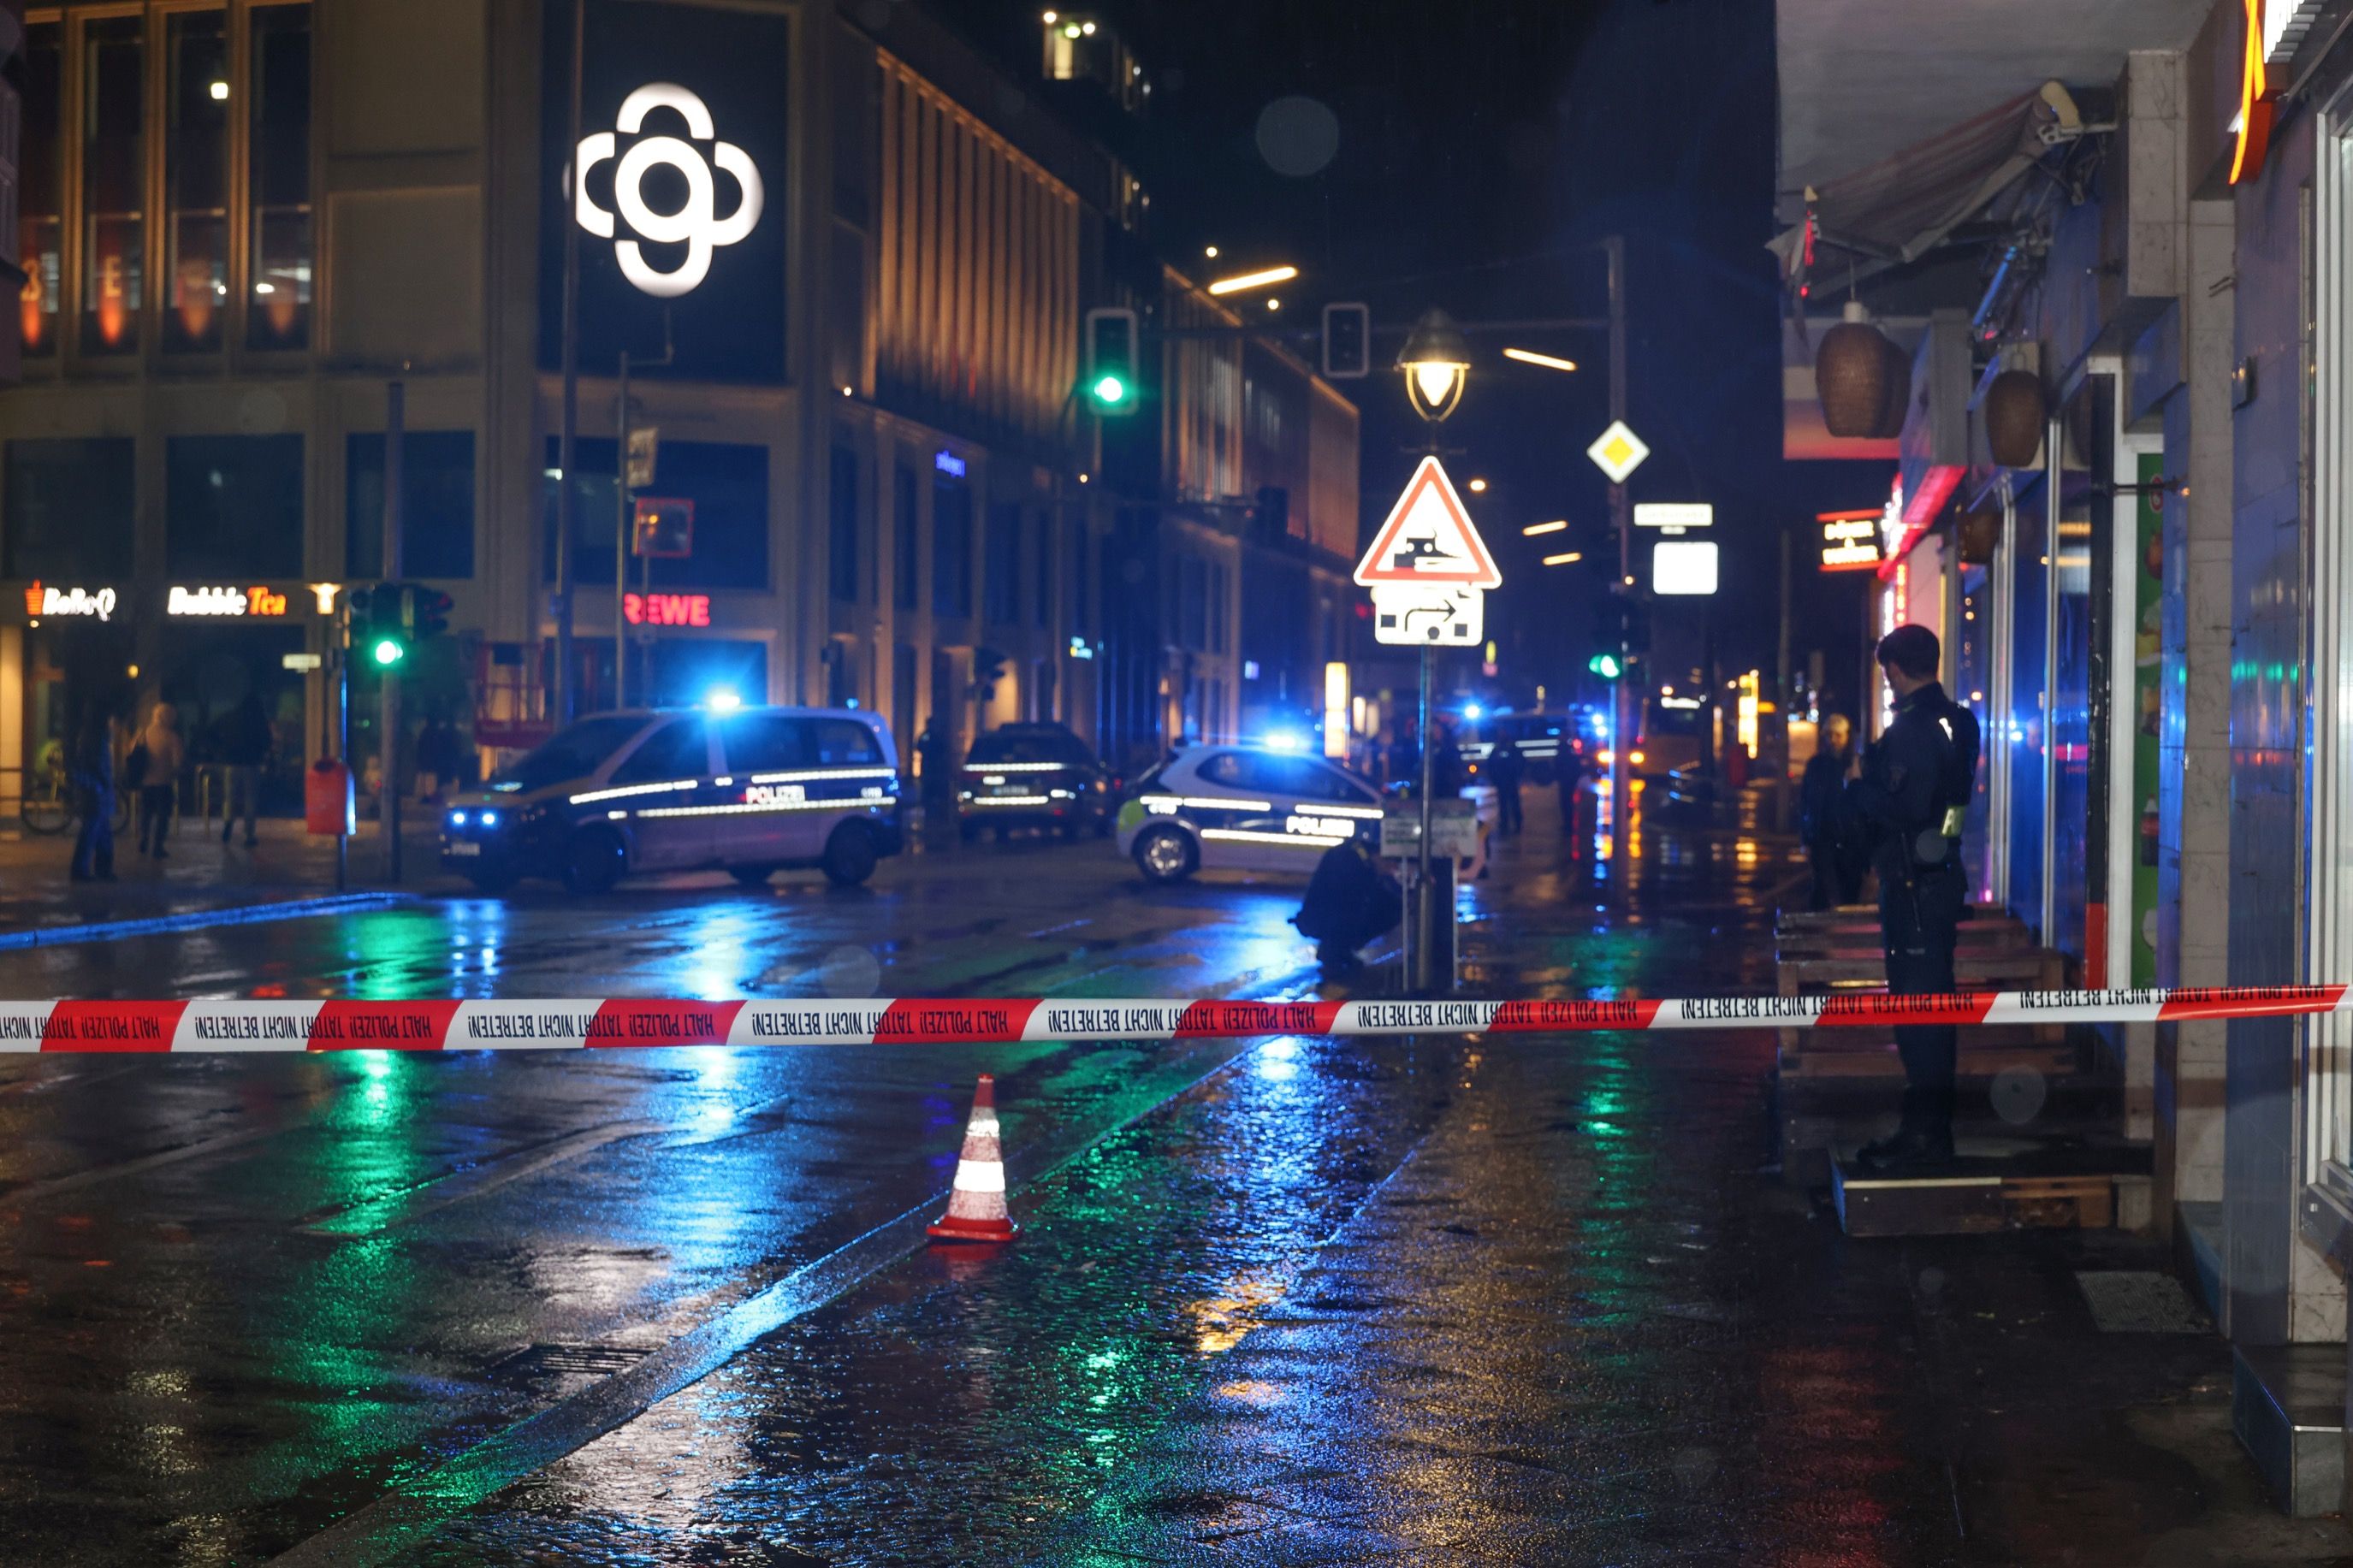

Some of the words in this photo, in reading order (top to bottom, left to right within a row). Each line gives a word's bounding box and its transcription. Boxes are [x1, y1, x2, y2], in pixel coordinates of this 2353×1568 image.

[247, 587, 286, 615] Tea
[624, 593, 710, 626] REWE
[1482, 1002, 1533, 1025] TATORT
[1541, 1001, 1597, 1023] POLIZEI!
[1603, 1001, 1638, 1021] HALT
[1763, 997, 1806, 1018] NICHT
[1811, 995, 1865, 1015] TATORT
[1938, 993, 1974, 1012] HALT
[300, 1015, 343, 1038] TATORT
[350, 1015, 398, 1038] POLIZEI!
[401, 1015, 432, 1038] HALT
[468, 1015, 534, 1038] BETRETEN!
[538, 1015, 574, 1038] NICHT
[578, 1015, 624, 1038] TATORT
[629, 1015, 679, 1038] POLIZEI!
[683, 1013, 715, 1037] HALT
[752, 1013, 820, 1036] BETRETEN!
[824, 1012, 862, 1035] NICHT
[866, 1011, 915, 1035] TATORT
[920, 1010, 973, 1034] POLIZEI!
[975, 1009, 1008, 1033] HALT
[1048, 1009, 1119, 1033] BETRETEN!
[1123, 1009, 1163, 1032] NICHT
[1167, 1008, 1218, 1032] TATORT
[1224, 1007, 1278, 1030] POLIZEI!
[1281, 1005, 1316, 1029] HALT
[1358, 1003, 1432, 1027] BETRETEN!
[1437, 1003, 1478, 1027] NICHT
[33, 1015, 77, 1039] TATORT
[81, 1015, 127, 1039] POLIZEI!
[130, 1015, 160, 1039] HALT
[195, 1016, 258, 1038] BETRETEN!
[262, 1016, 297, 1039] NICHT
